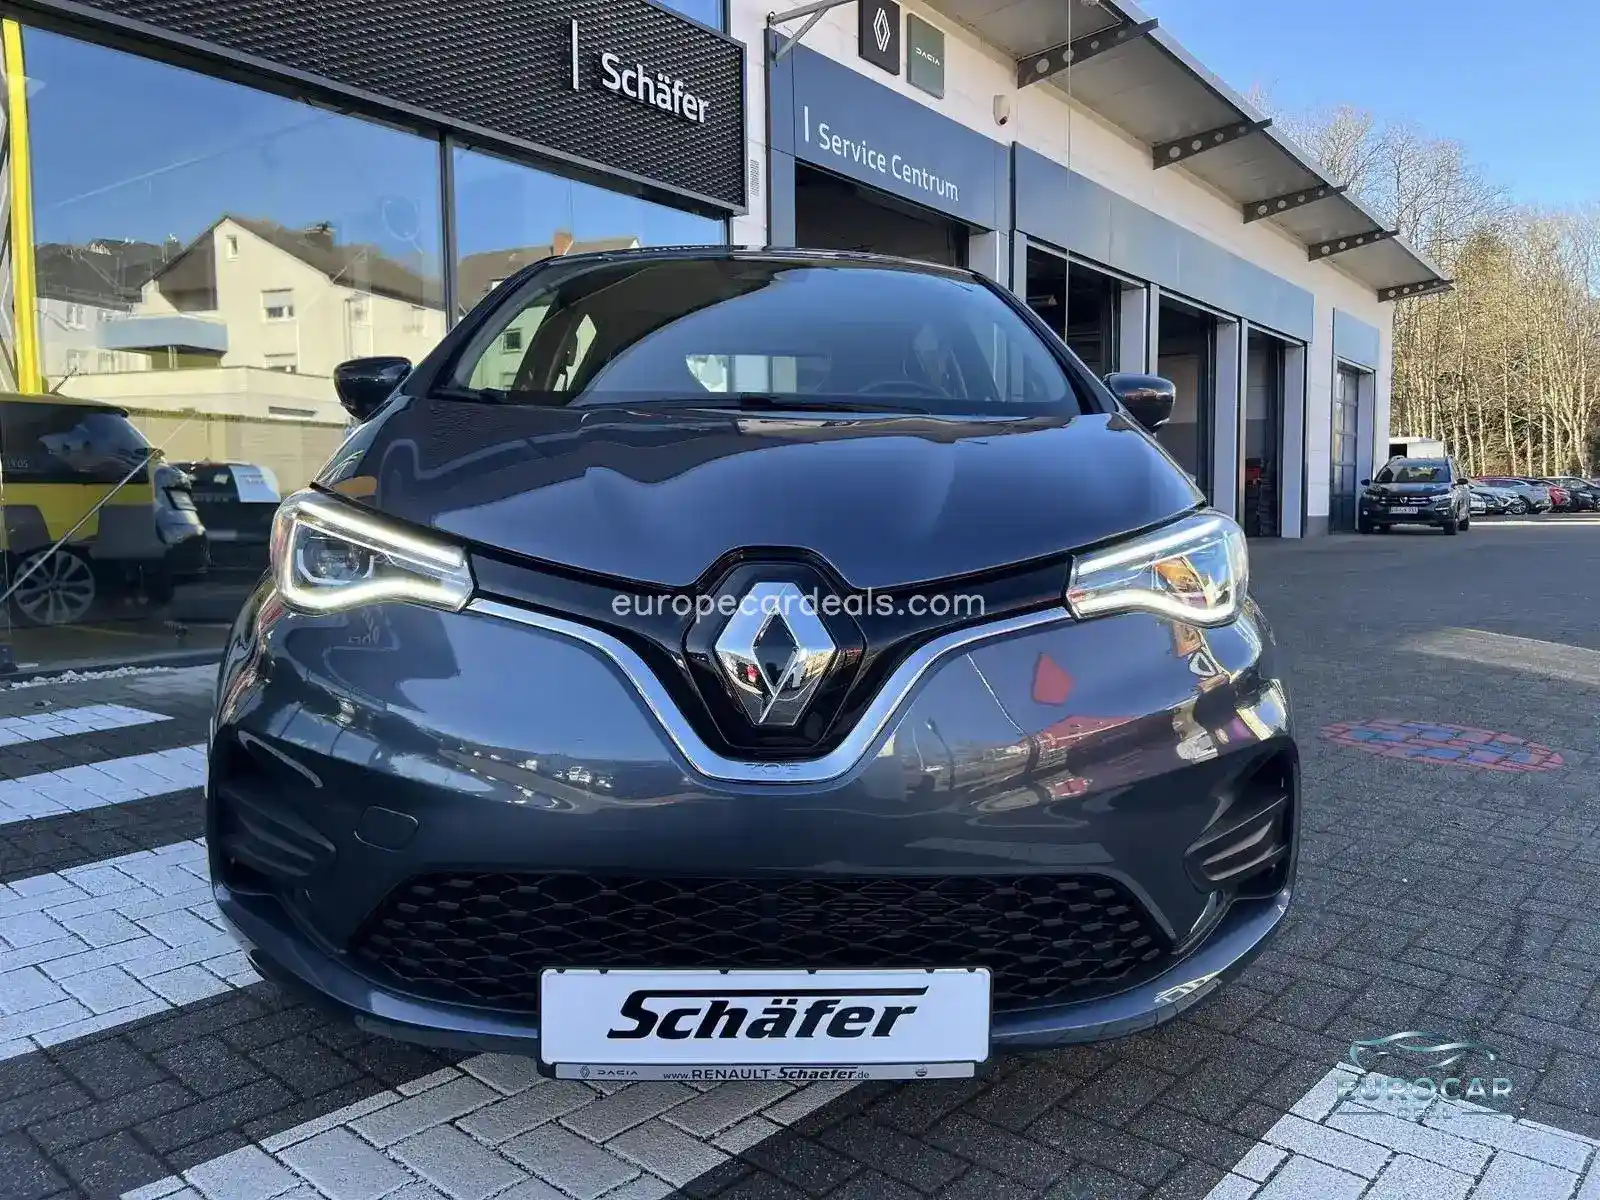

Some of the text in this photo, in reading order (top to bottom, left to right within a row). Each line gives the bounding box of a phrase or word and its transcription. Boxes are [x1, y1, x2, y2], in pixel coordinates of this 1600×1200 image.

[601, 51, 709, 124] Schäfer
[818, 123, 960, 202] Service Centrum
[606, 985, 929, 1040] Schäfer
[663, 1066, 870, 1081] www.RENAULT-Schaefer.de
